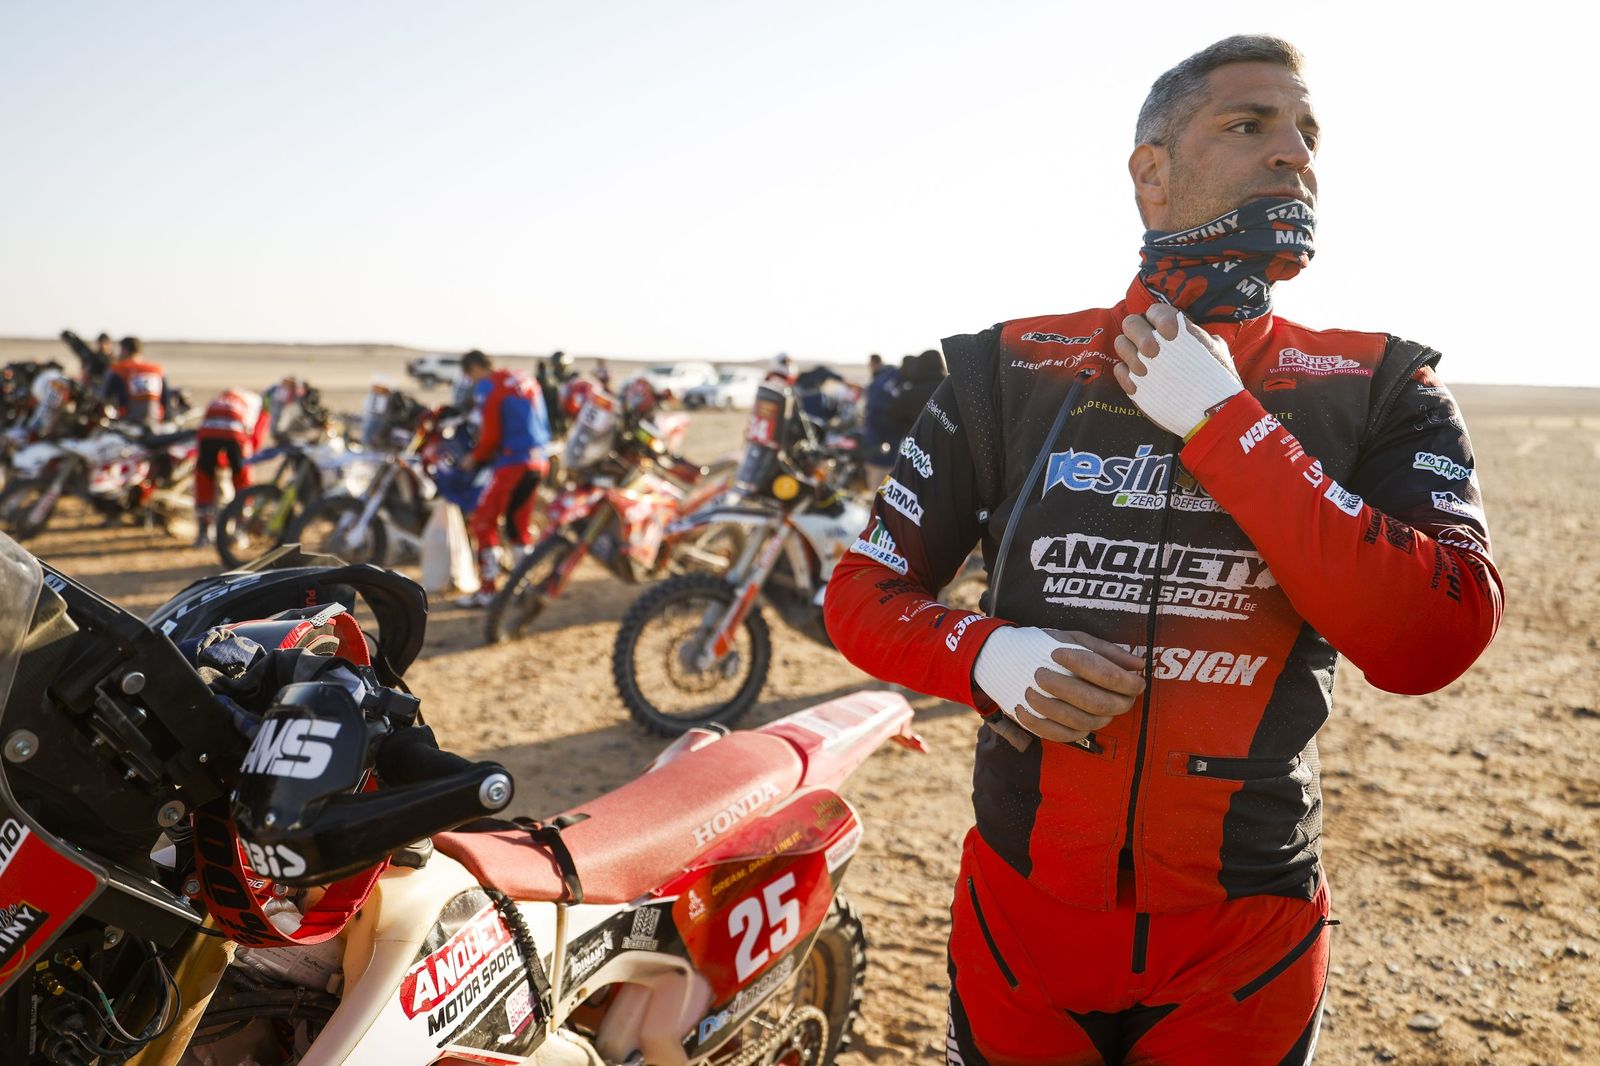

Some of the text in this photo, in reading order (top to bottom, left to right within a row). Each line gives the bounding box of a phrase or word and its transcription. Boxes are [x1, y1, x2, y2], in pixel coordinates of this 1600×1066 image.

[1011, 357, 1052, 371] LEJEUNE
[1282, 348, 1340, 363] CENTRE
[1334, 368, 1369, 376] boissons
[1070, 400, 1293, 420] VANDERLINDE ITE
[941, 411, 958, 434] Royal
[1130, 495, 1164, 508] ZERO
[857, 540, 907, 571] ULTISEPA
[1038, 540, 1268, 588] ANQUETY
[1043, 576, 1143, 601] MOTOR
[691, 782, 781, 849] HONDA
[727, 872, 801, 983] 25
[427, 981, 482, 1037] MOTOR
